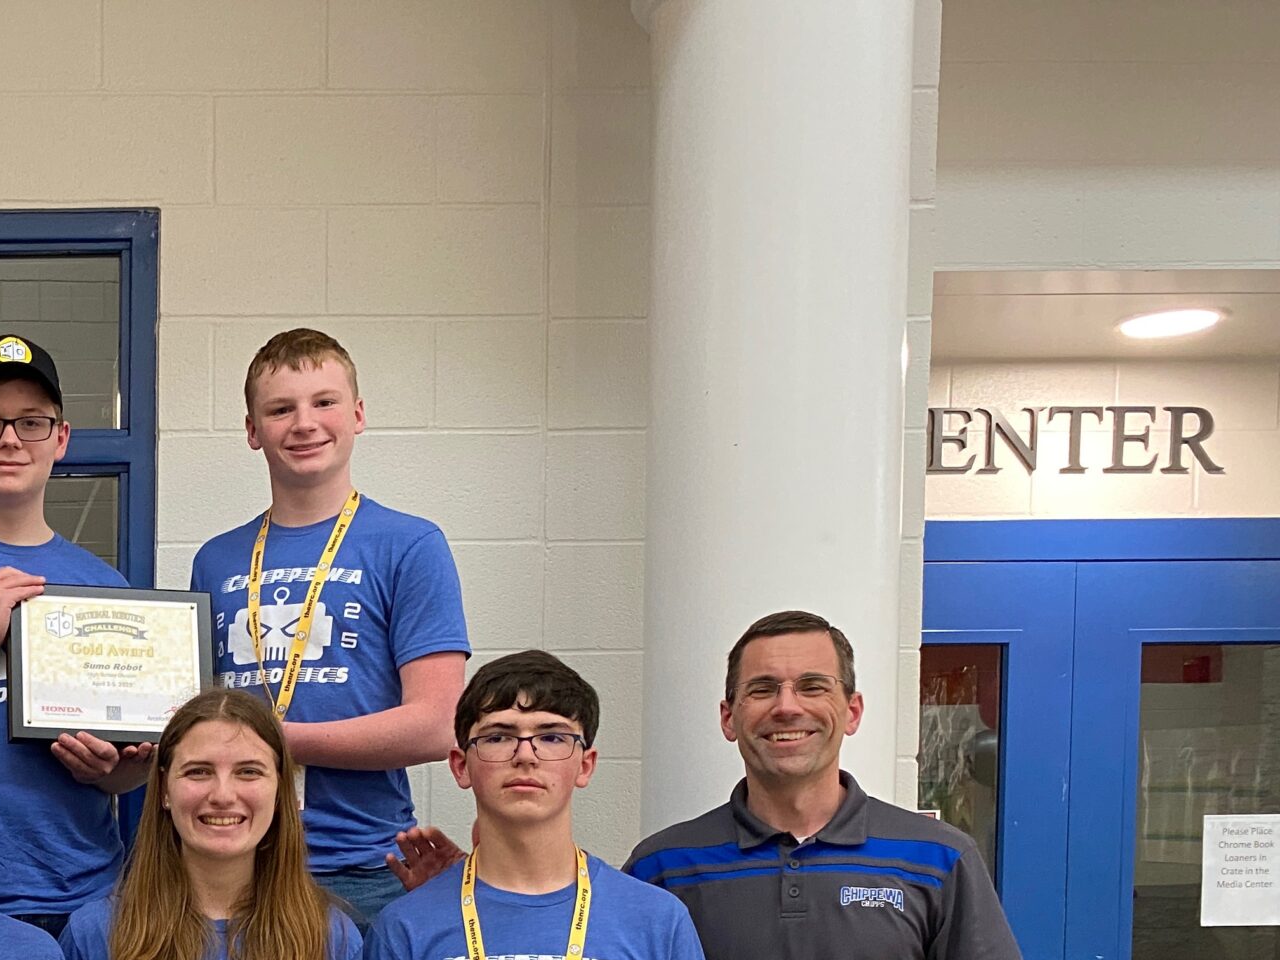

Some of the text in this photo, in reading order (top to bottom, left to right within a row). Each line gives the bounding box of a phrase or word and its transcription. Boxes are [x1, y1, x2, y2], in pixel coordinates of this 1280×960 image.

[926, 406, 1225, 476] ENTER
[328, 524, 346, 553] thenrc.org
[304, 581, 321, 619] thenrc.org
[344, 602, 361, 619] 2
[84, 624, 138, 635] CHALLENGE
[341, 632, 358, 649] 5
[71, 642, 154, 658] Gold Award
[83, 662, 143, 671] Sumo Robot
[284, 653, 300, 692] thenrc.org
[221, 667, 349, 689] ROBOICS
[1222, 828, 1249, 836] Please
[1245, 880, 1273, 888] Center
[576, 888, 588, 930] thenrc.org
[840, 886, 904, 912] CHIPPEWA
[469, 919, 480, 960] thenrc.org
